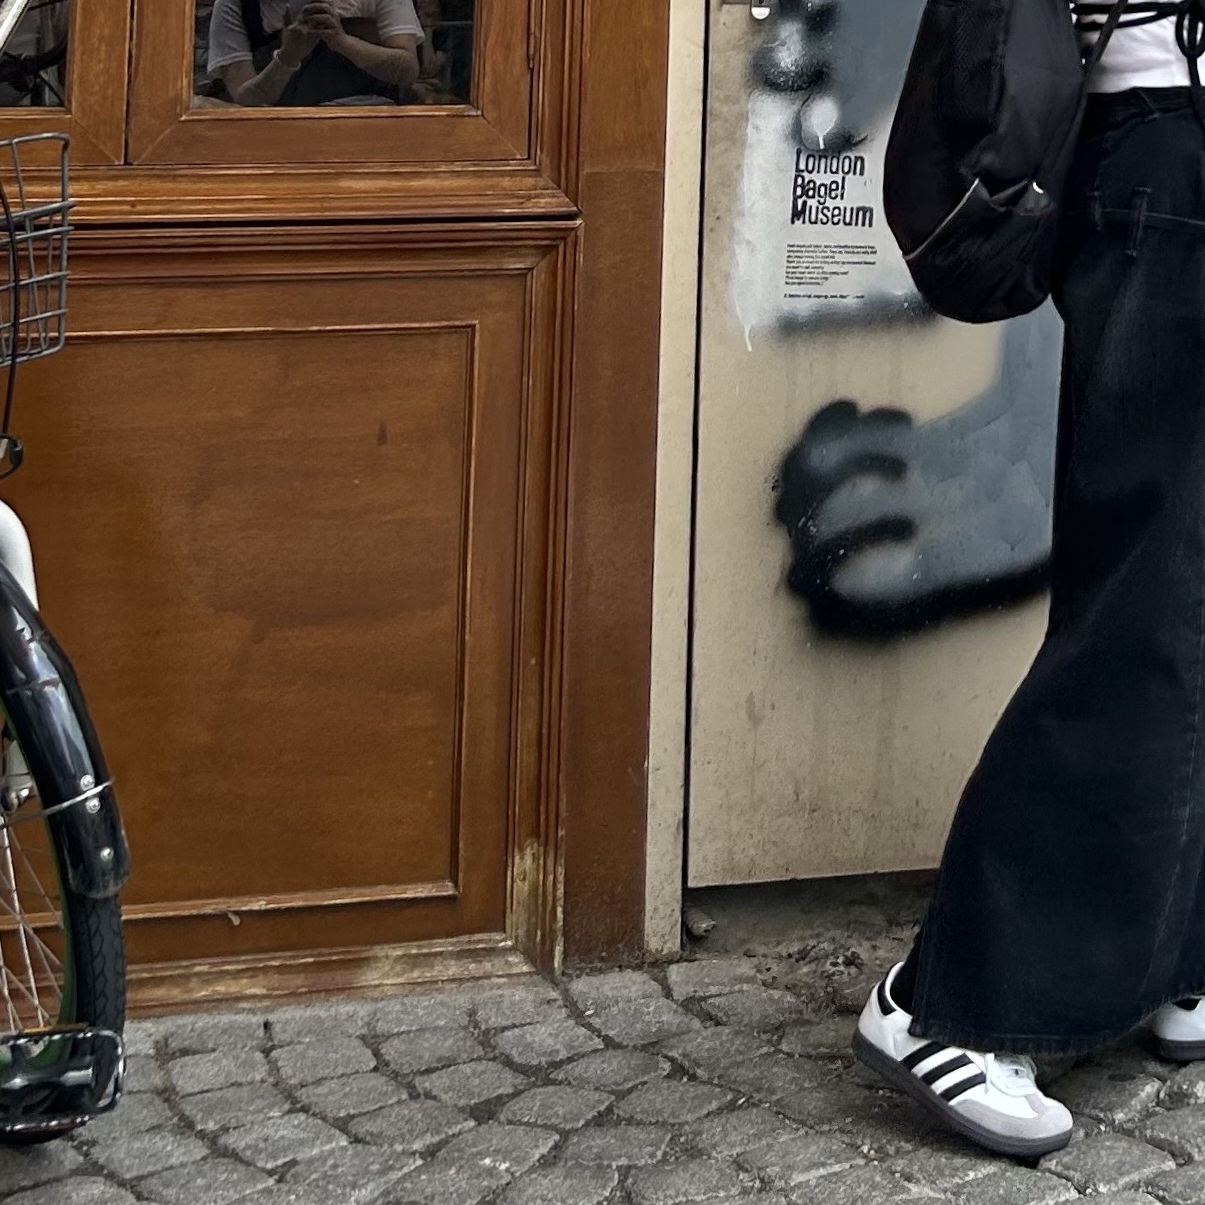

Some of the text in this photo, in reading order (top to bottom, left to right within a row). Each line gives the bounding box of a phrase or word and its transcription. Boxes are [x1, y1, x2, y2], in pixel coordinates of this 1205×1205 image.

[795, 149, 865, 176] London
[793, 175, 846, 205] Bagel
[791, 200, 874, 228] Museum
